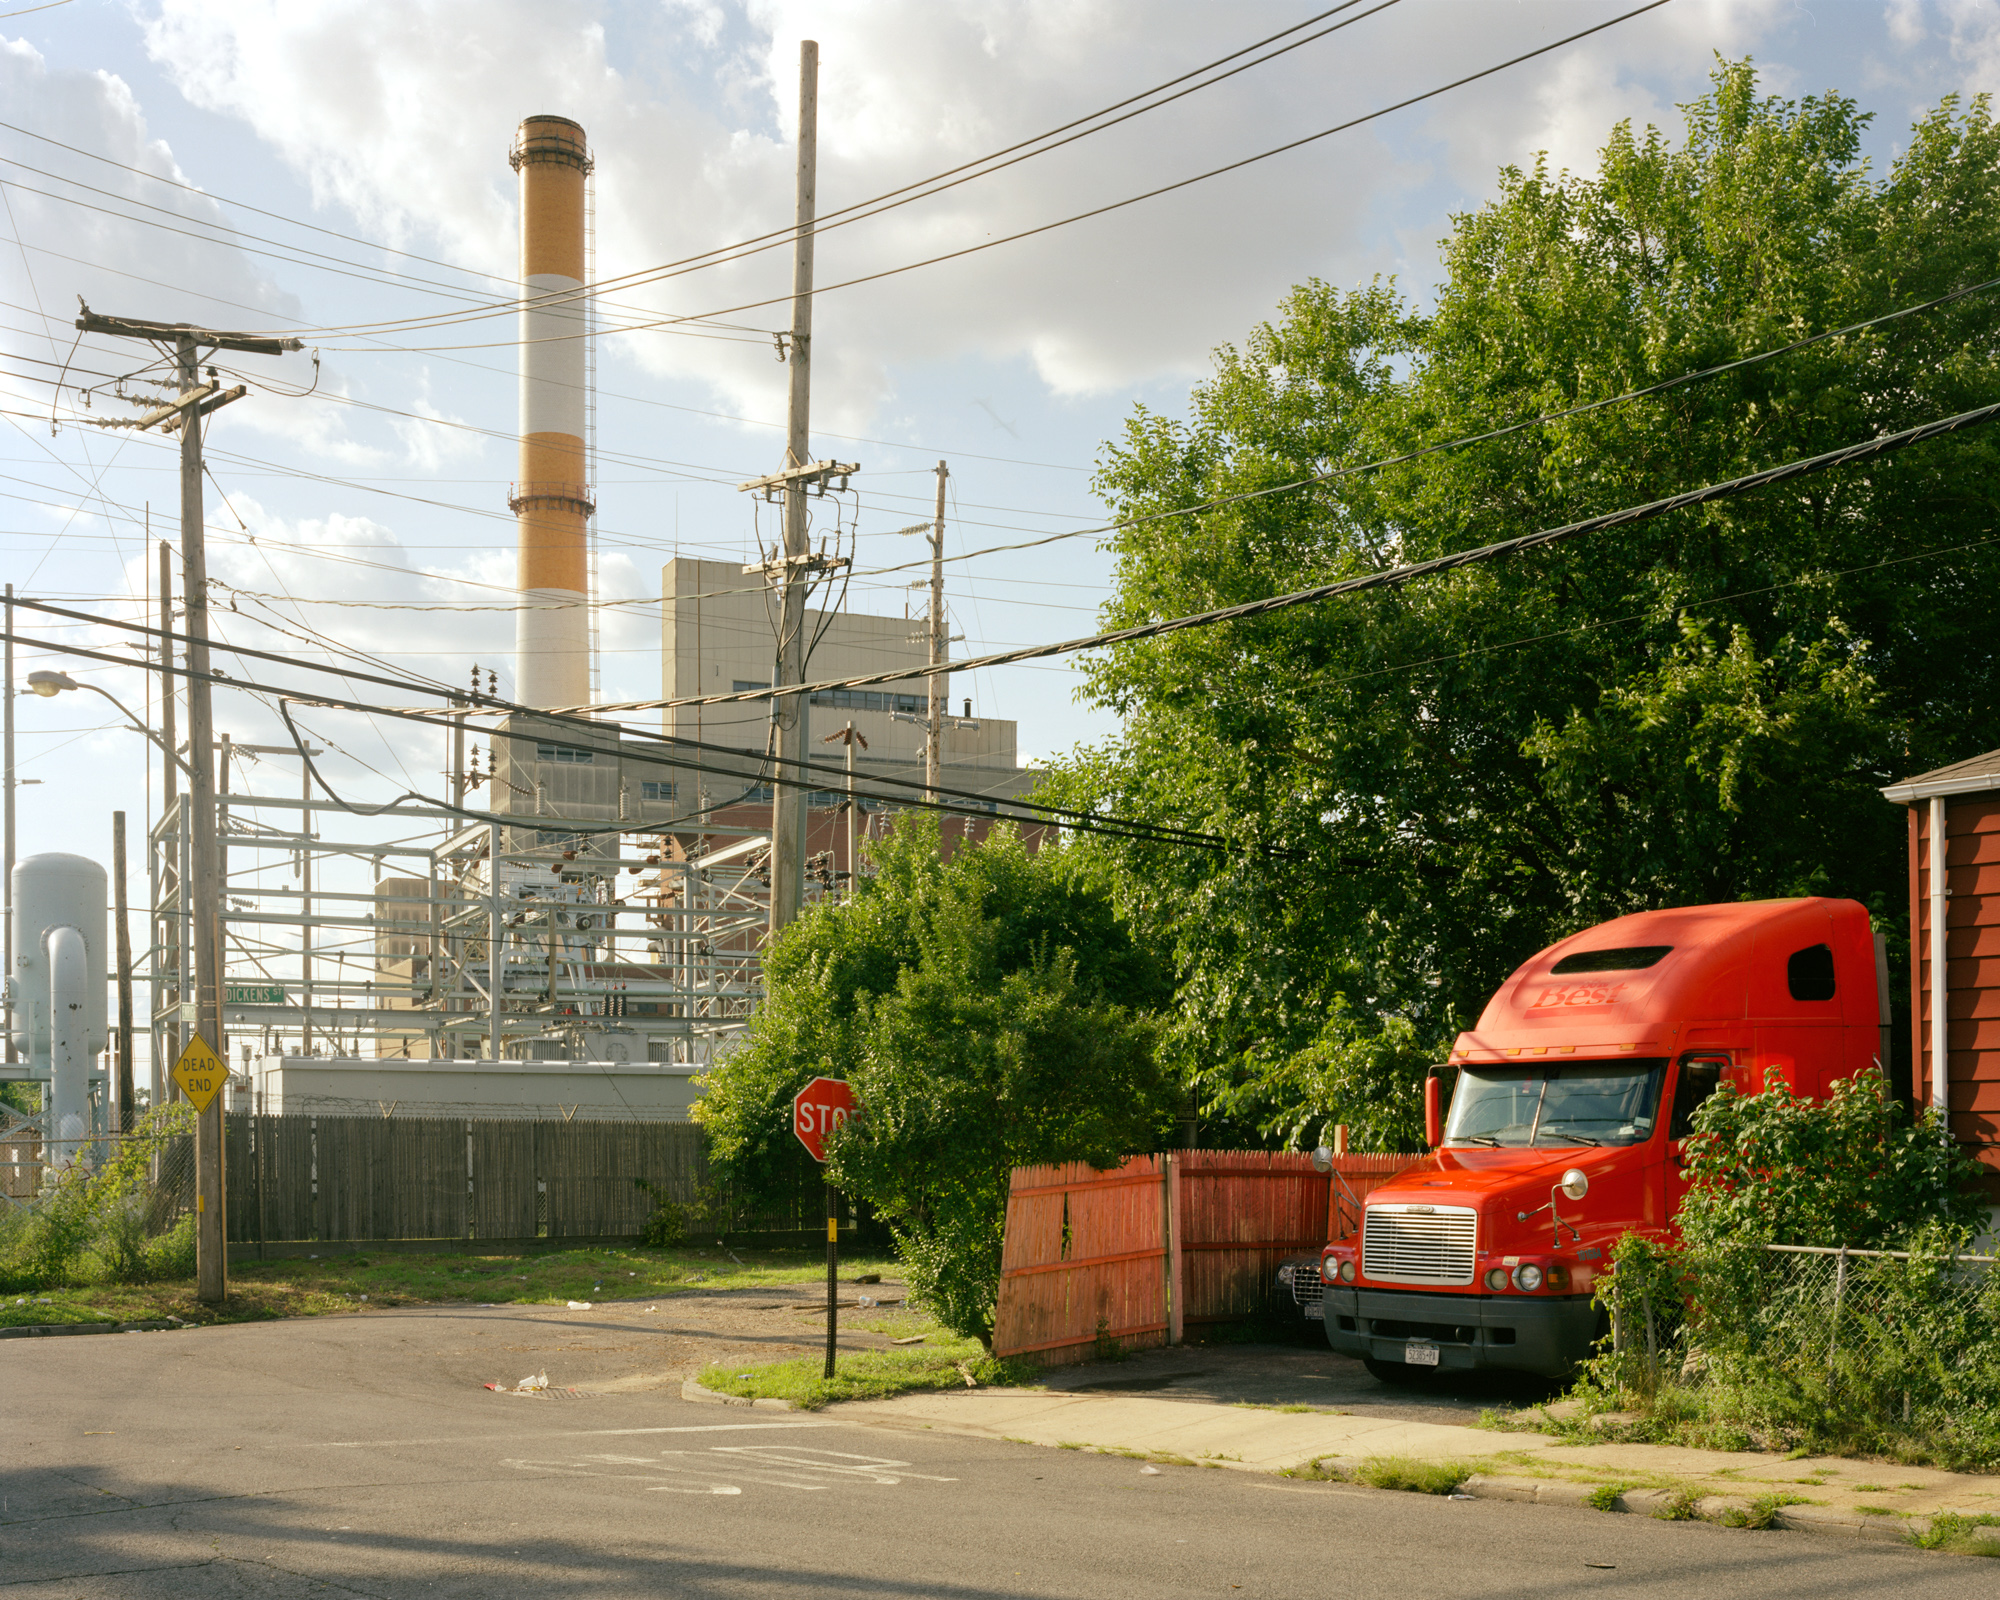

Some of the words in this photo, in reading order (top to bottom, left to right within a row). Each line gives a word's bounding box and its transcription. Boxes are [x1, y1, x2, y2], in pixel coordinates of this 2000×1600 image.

[225, 987, 270, 1002] DICKENS
[272, 987, 283, 996] ST
[1528, 981, 1629, 1009] Best
[183, 1057, 215, 1072] DEAD
[188, 1078, 212, 1092] END
